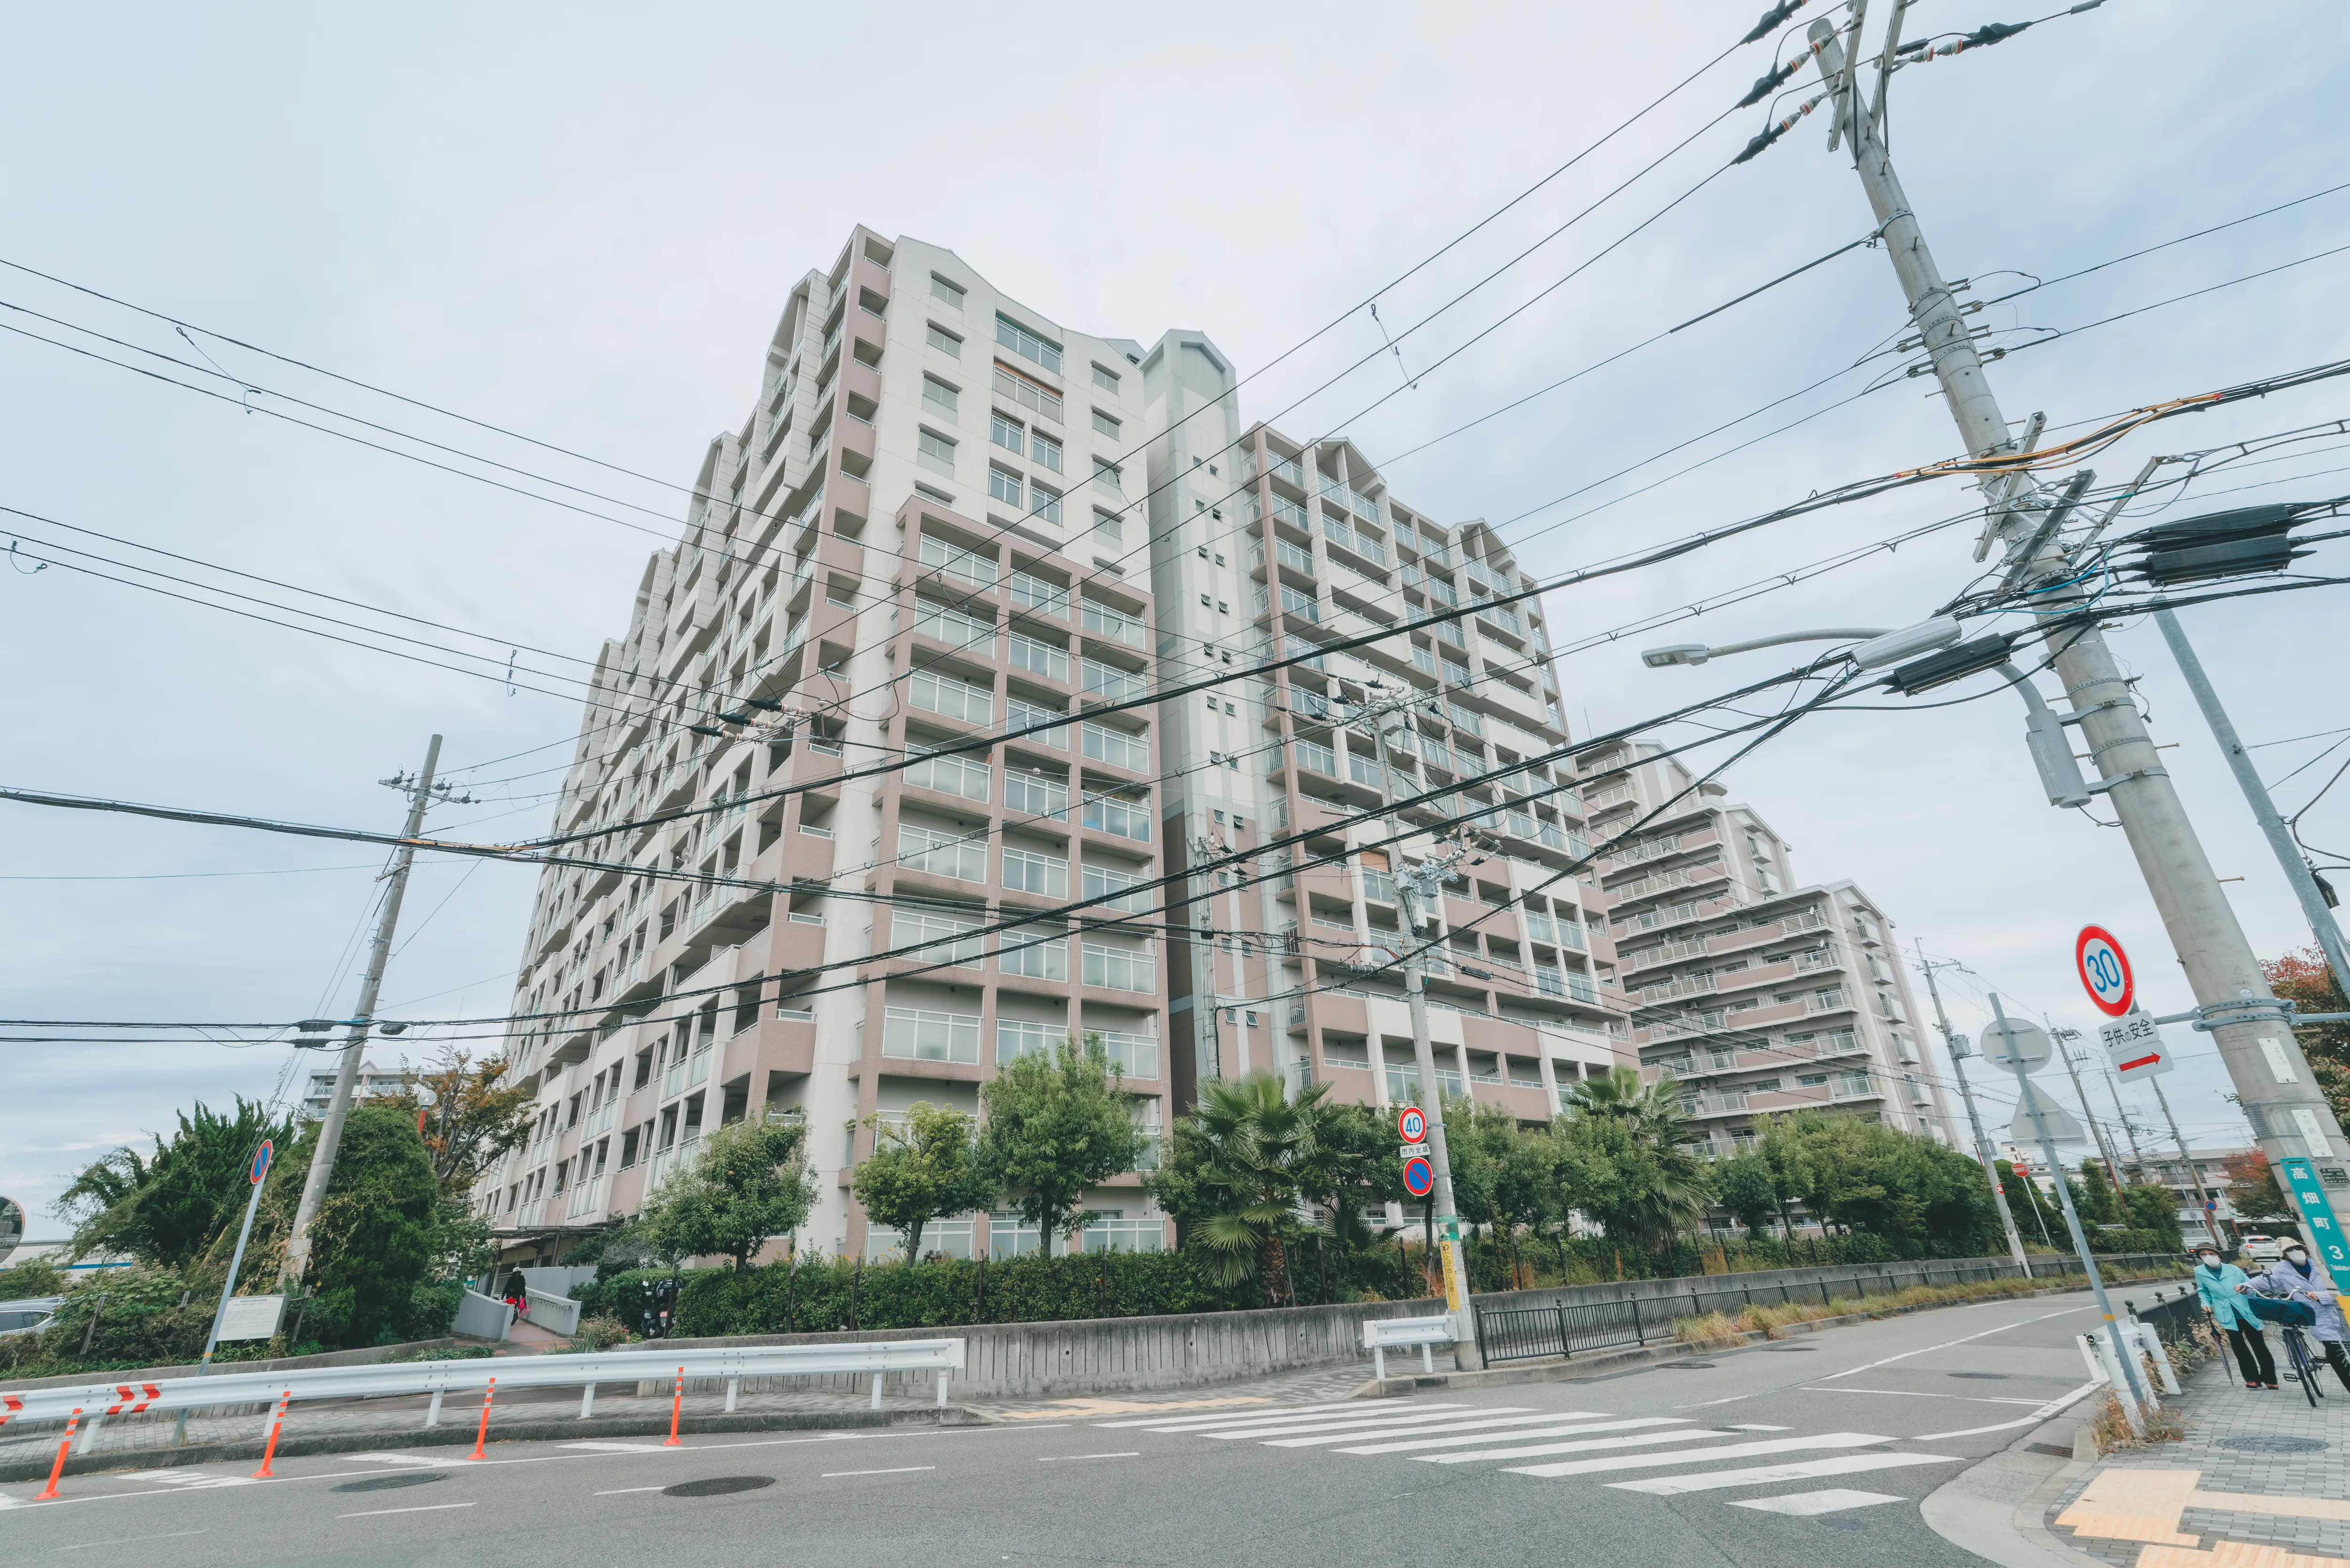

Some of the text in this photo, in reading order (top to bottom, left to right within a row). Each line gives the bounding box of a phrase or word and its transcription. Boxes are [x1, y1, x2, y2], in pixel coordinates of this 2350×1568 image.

[2087, 949, 2120, 993] 30
[2103, 1018, 2154, 1047] 子供の安全
[1406, 1117, 1421, 1133] 40
[1402, 1146, 1428, 1155] 市内全域
